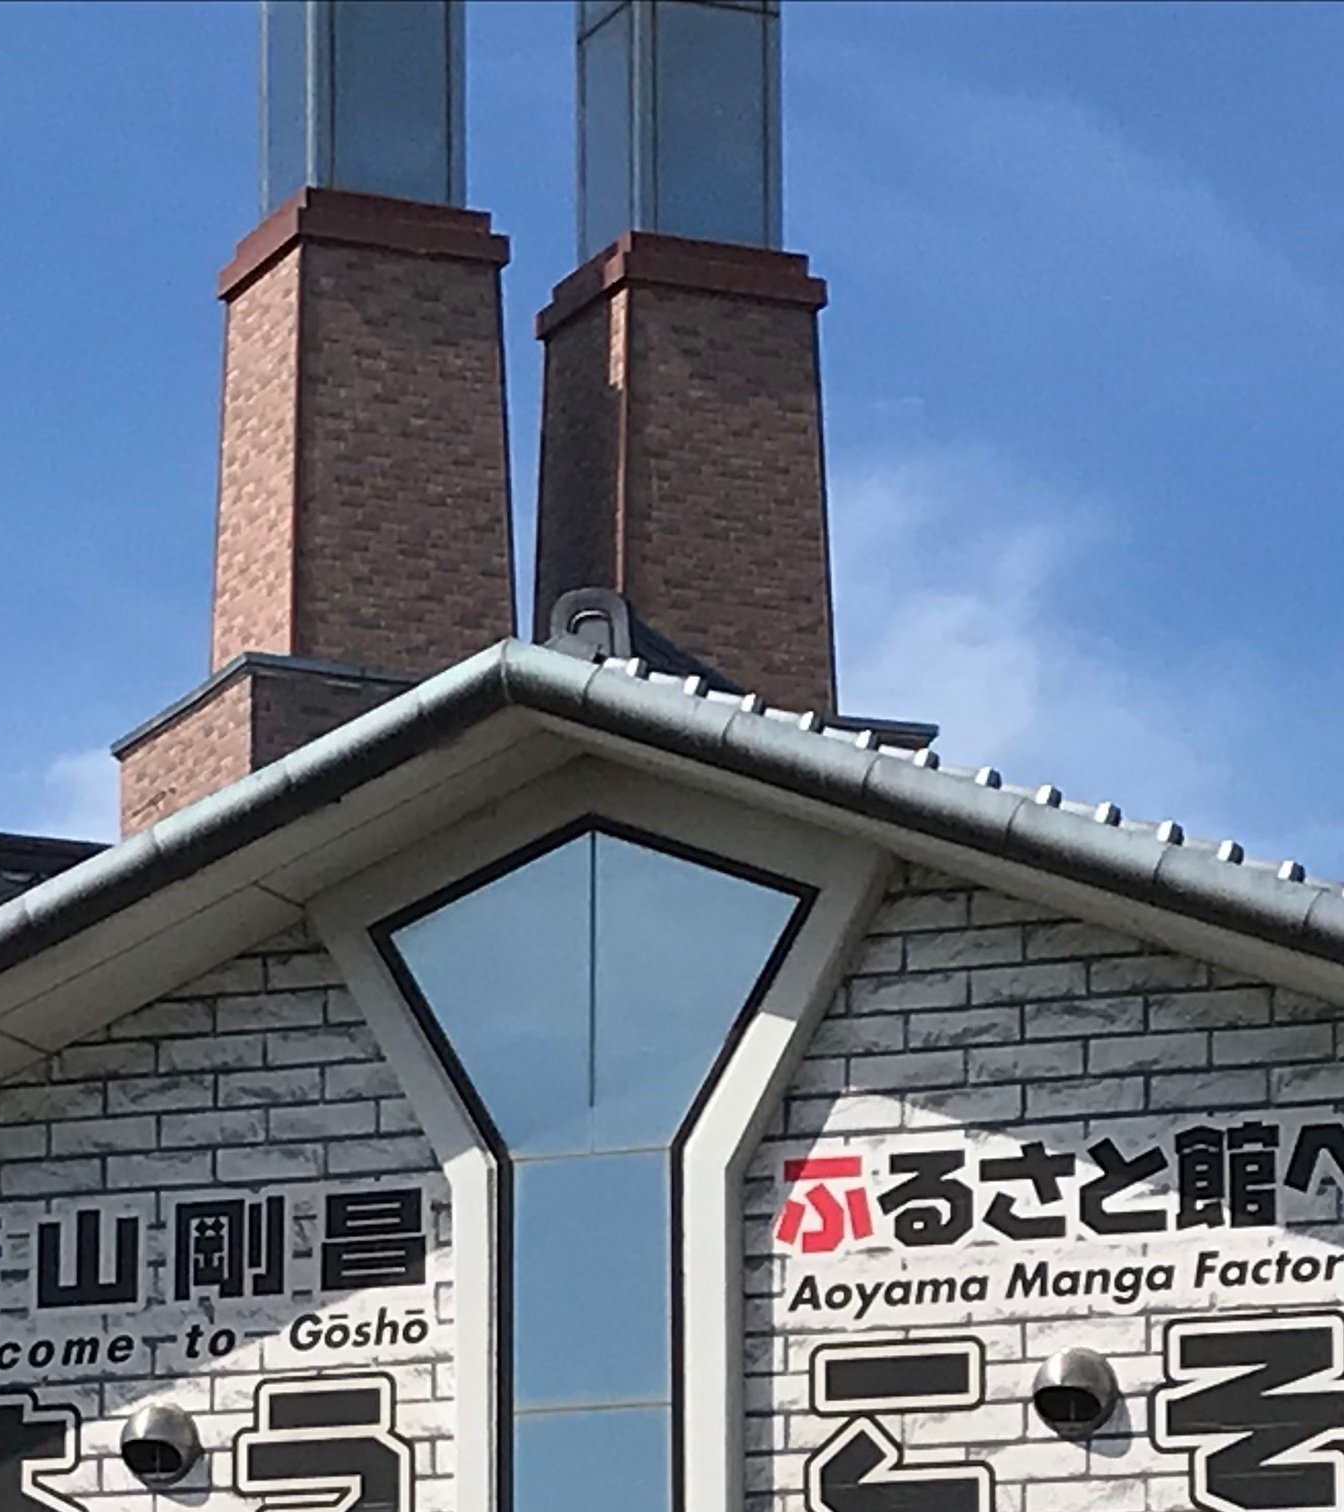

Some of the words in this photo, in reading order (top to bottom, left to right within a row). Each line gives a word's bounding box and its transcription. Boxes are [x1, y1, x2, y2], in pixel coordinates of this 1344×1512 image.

[787, 1274, 988, 1320] Aoyama
[1004, 1260, 1174, 1305] Manga
[184, 1323, 237, 1359] to
